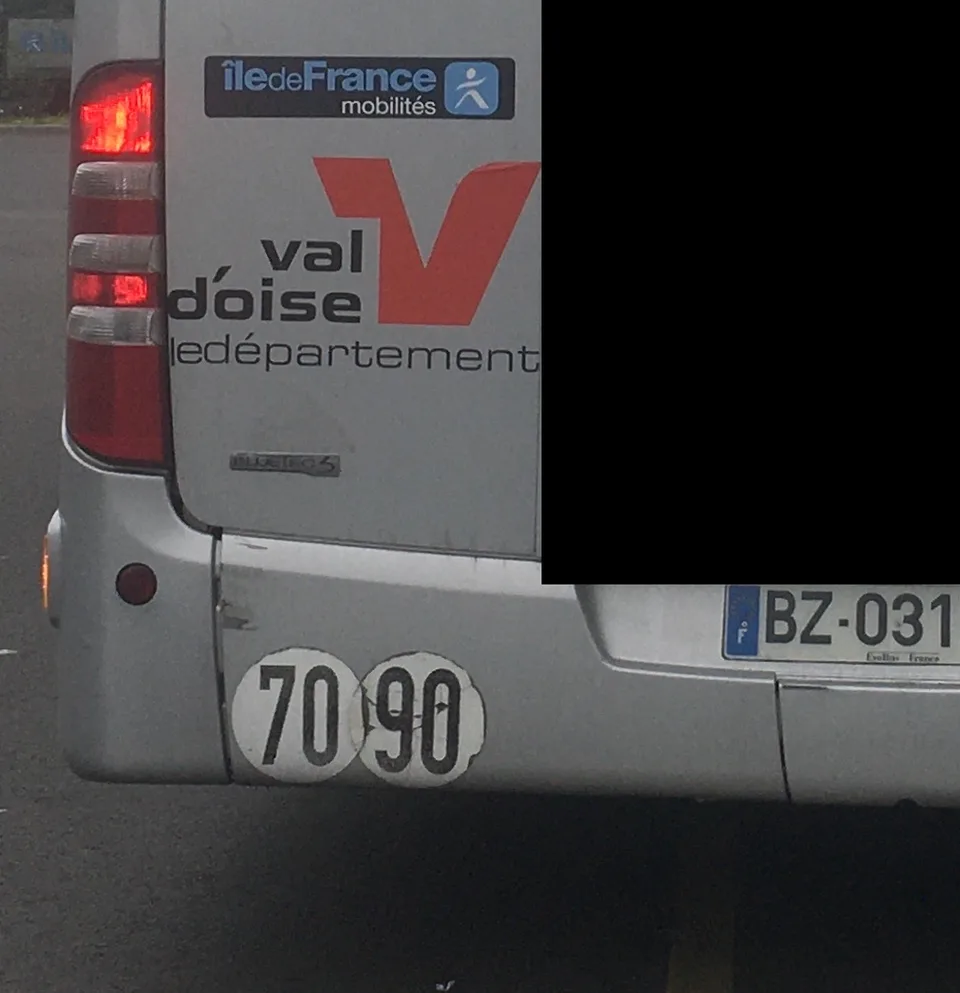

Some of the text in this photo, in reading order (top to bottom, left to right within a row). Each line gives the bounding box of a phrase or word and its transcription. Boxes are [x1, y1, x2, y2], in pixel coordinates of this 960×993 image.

[341, 95, 437, 116] mobilités
[261, 229, 363, 273] val
[259, 664, 339, 767] 70
[374, 666, 462, 775] 90
